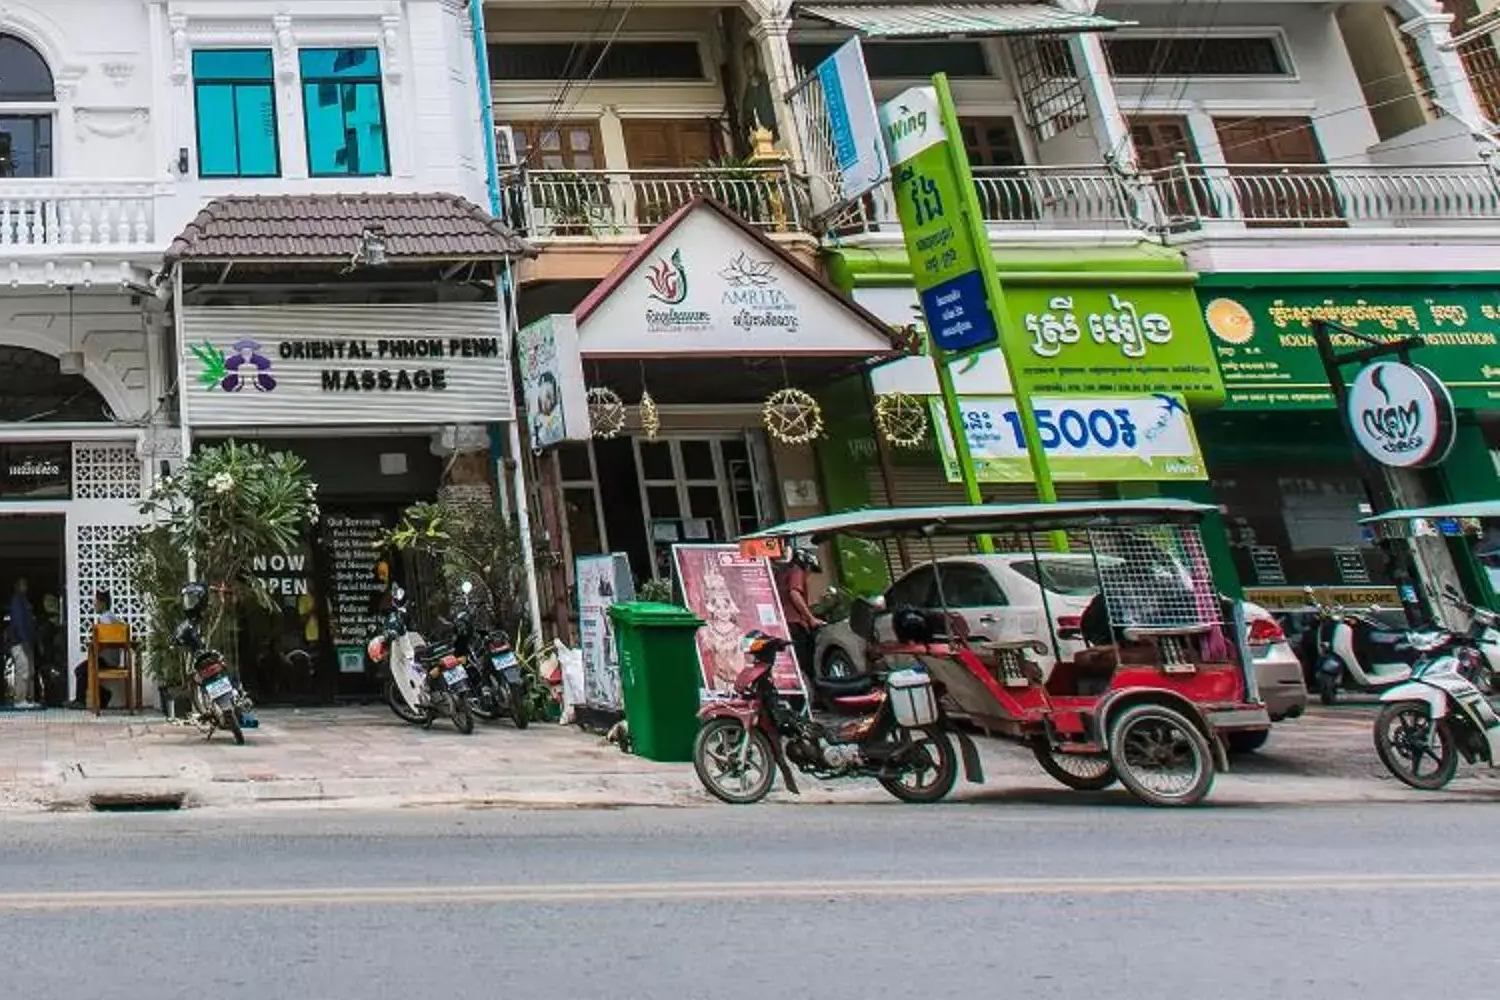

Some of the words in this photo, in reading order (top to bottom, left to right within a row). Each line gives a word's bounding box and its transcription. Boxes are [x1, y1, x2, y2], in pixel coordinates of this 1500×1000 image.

[888, 110, 928, 142] Wing
[279, 341, 372, 359] ORIENTAL
[378, 339, 443, 358] PHNOM
[449, 337, 498, 357] PENH
[321, 368, 447, 391] MASSAGE
[253, 555, 305, 571] NOW
